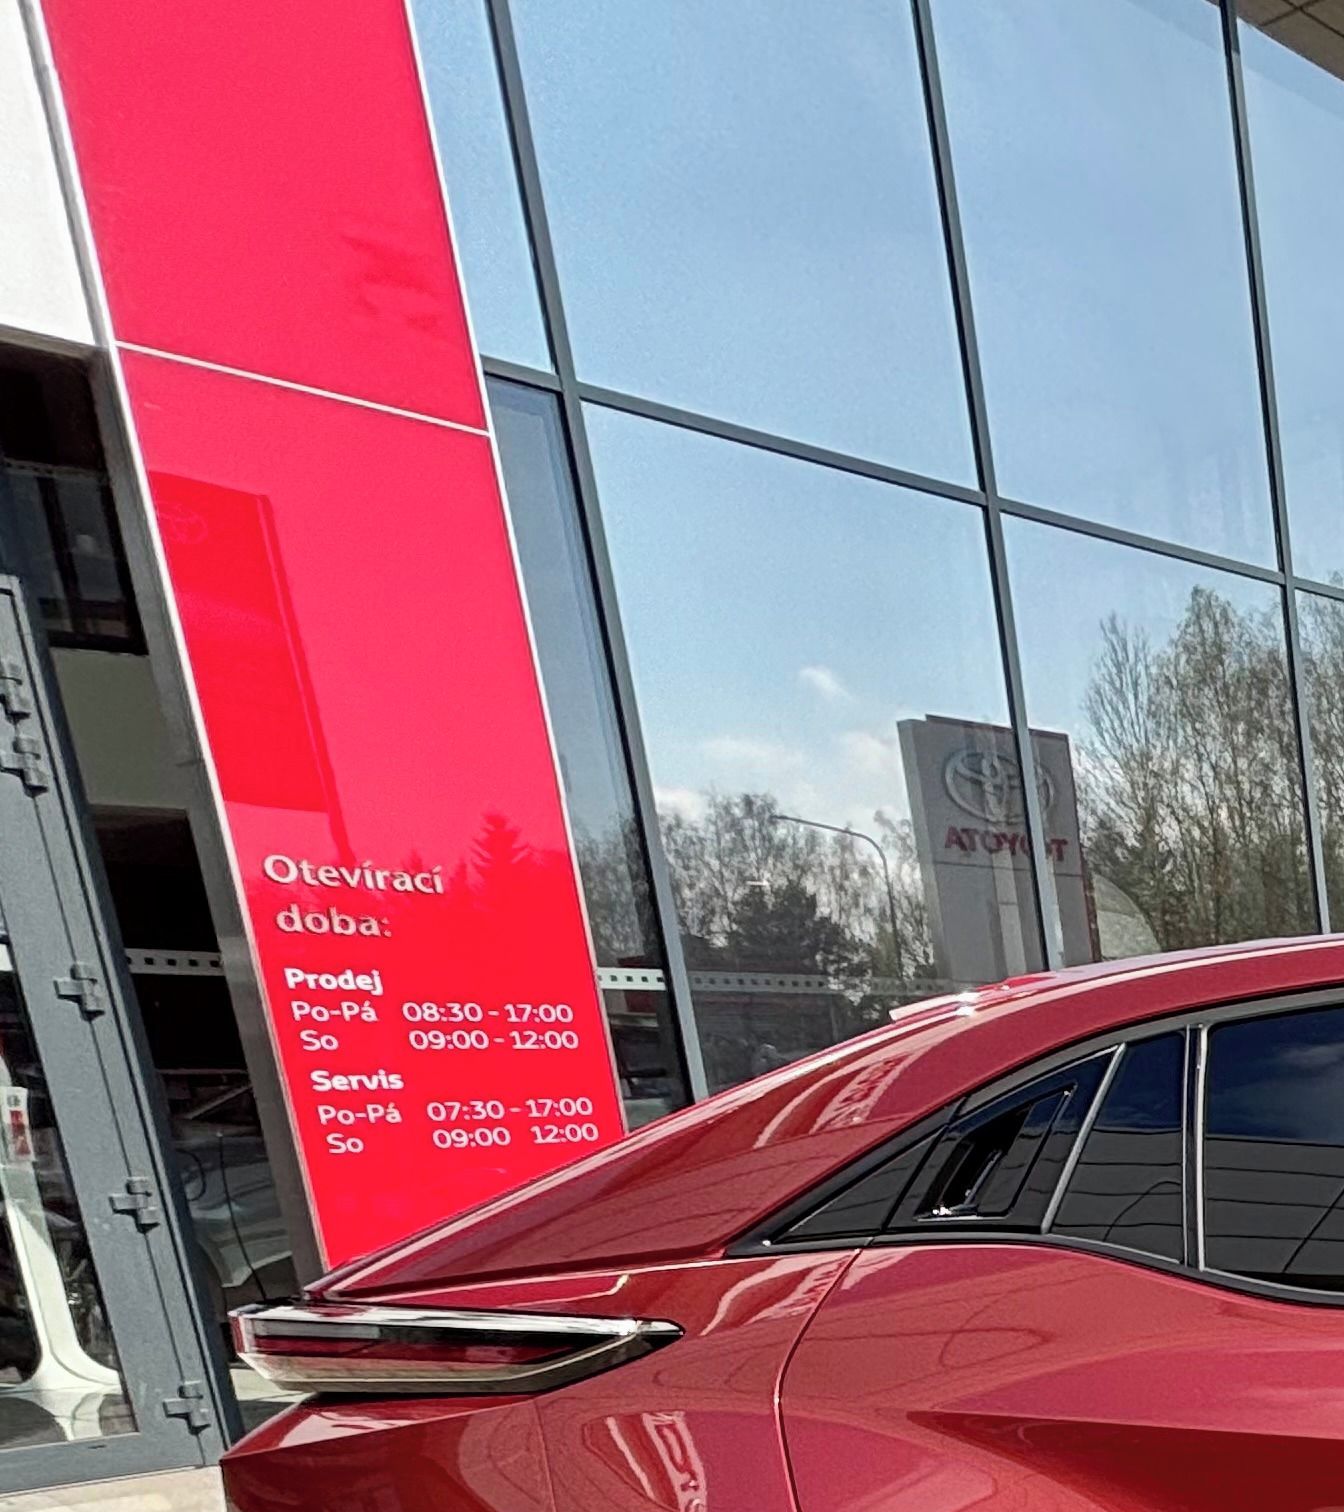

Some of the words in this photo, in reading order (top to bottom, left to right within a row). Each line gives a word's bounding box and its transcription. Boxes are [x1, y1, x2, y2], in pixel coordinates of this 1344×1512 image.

[263, 853, 445, 895] Otevírací
[276, 903, 393, 938] doba:
[284, 967, 384, 996] Prodej
[291, 1001, 379, 1023] Po-Pá
[402, 1002, 483, 1024] 08:30
[505, 1003, 574, 1024] 17:00
[300, 1029, 340, 1052] So
[409, 1030, 490, 1051] 09:00
[511, 1030, 580, 1051] 12:00
[310, 1069, 405, 1093] Servis
[317, 1103, 403, 1126] Po-Pá
[427, 1100, 506, 1122] 07:30
[526, 1097, 594, 1118] 17:00
[326, 1133, 365, 1155] So
[432, 1127, 512, 1150] 09:00
[531, 1123, 600, 1145] 12:00
